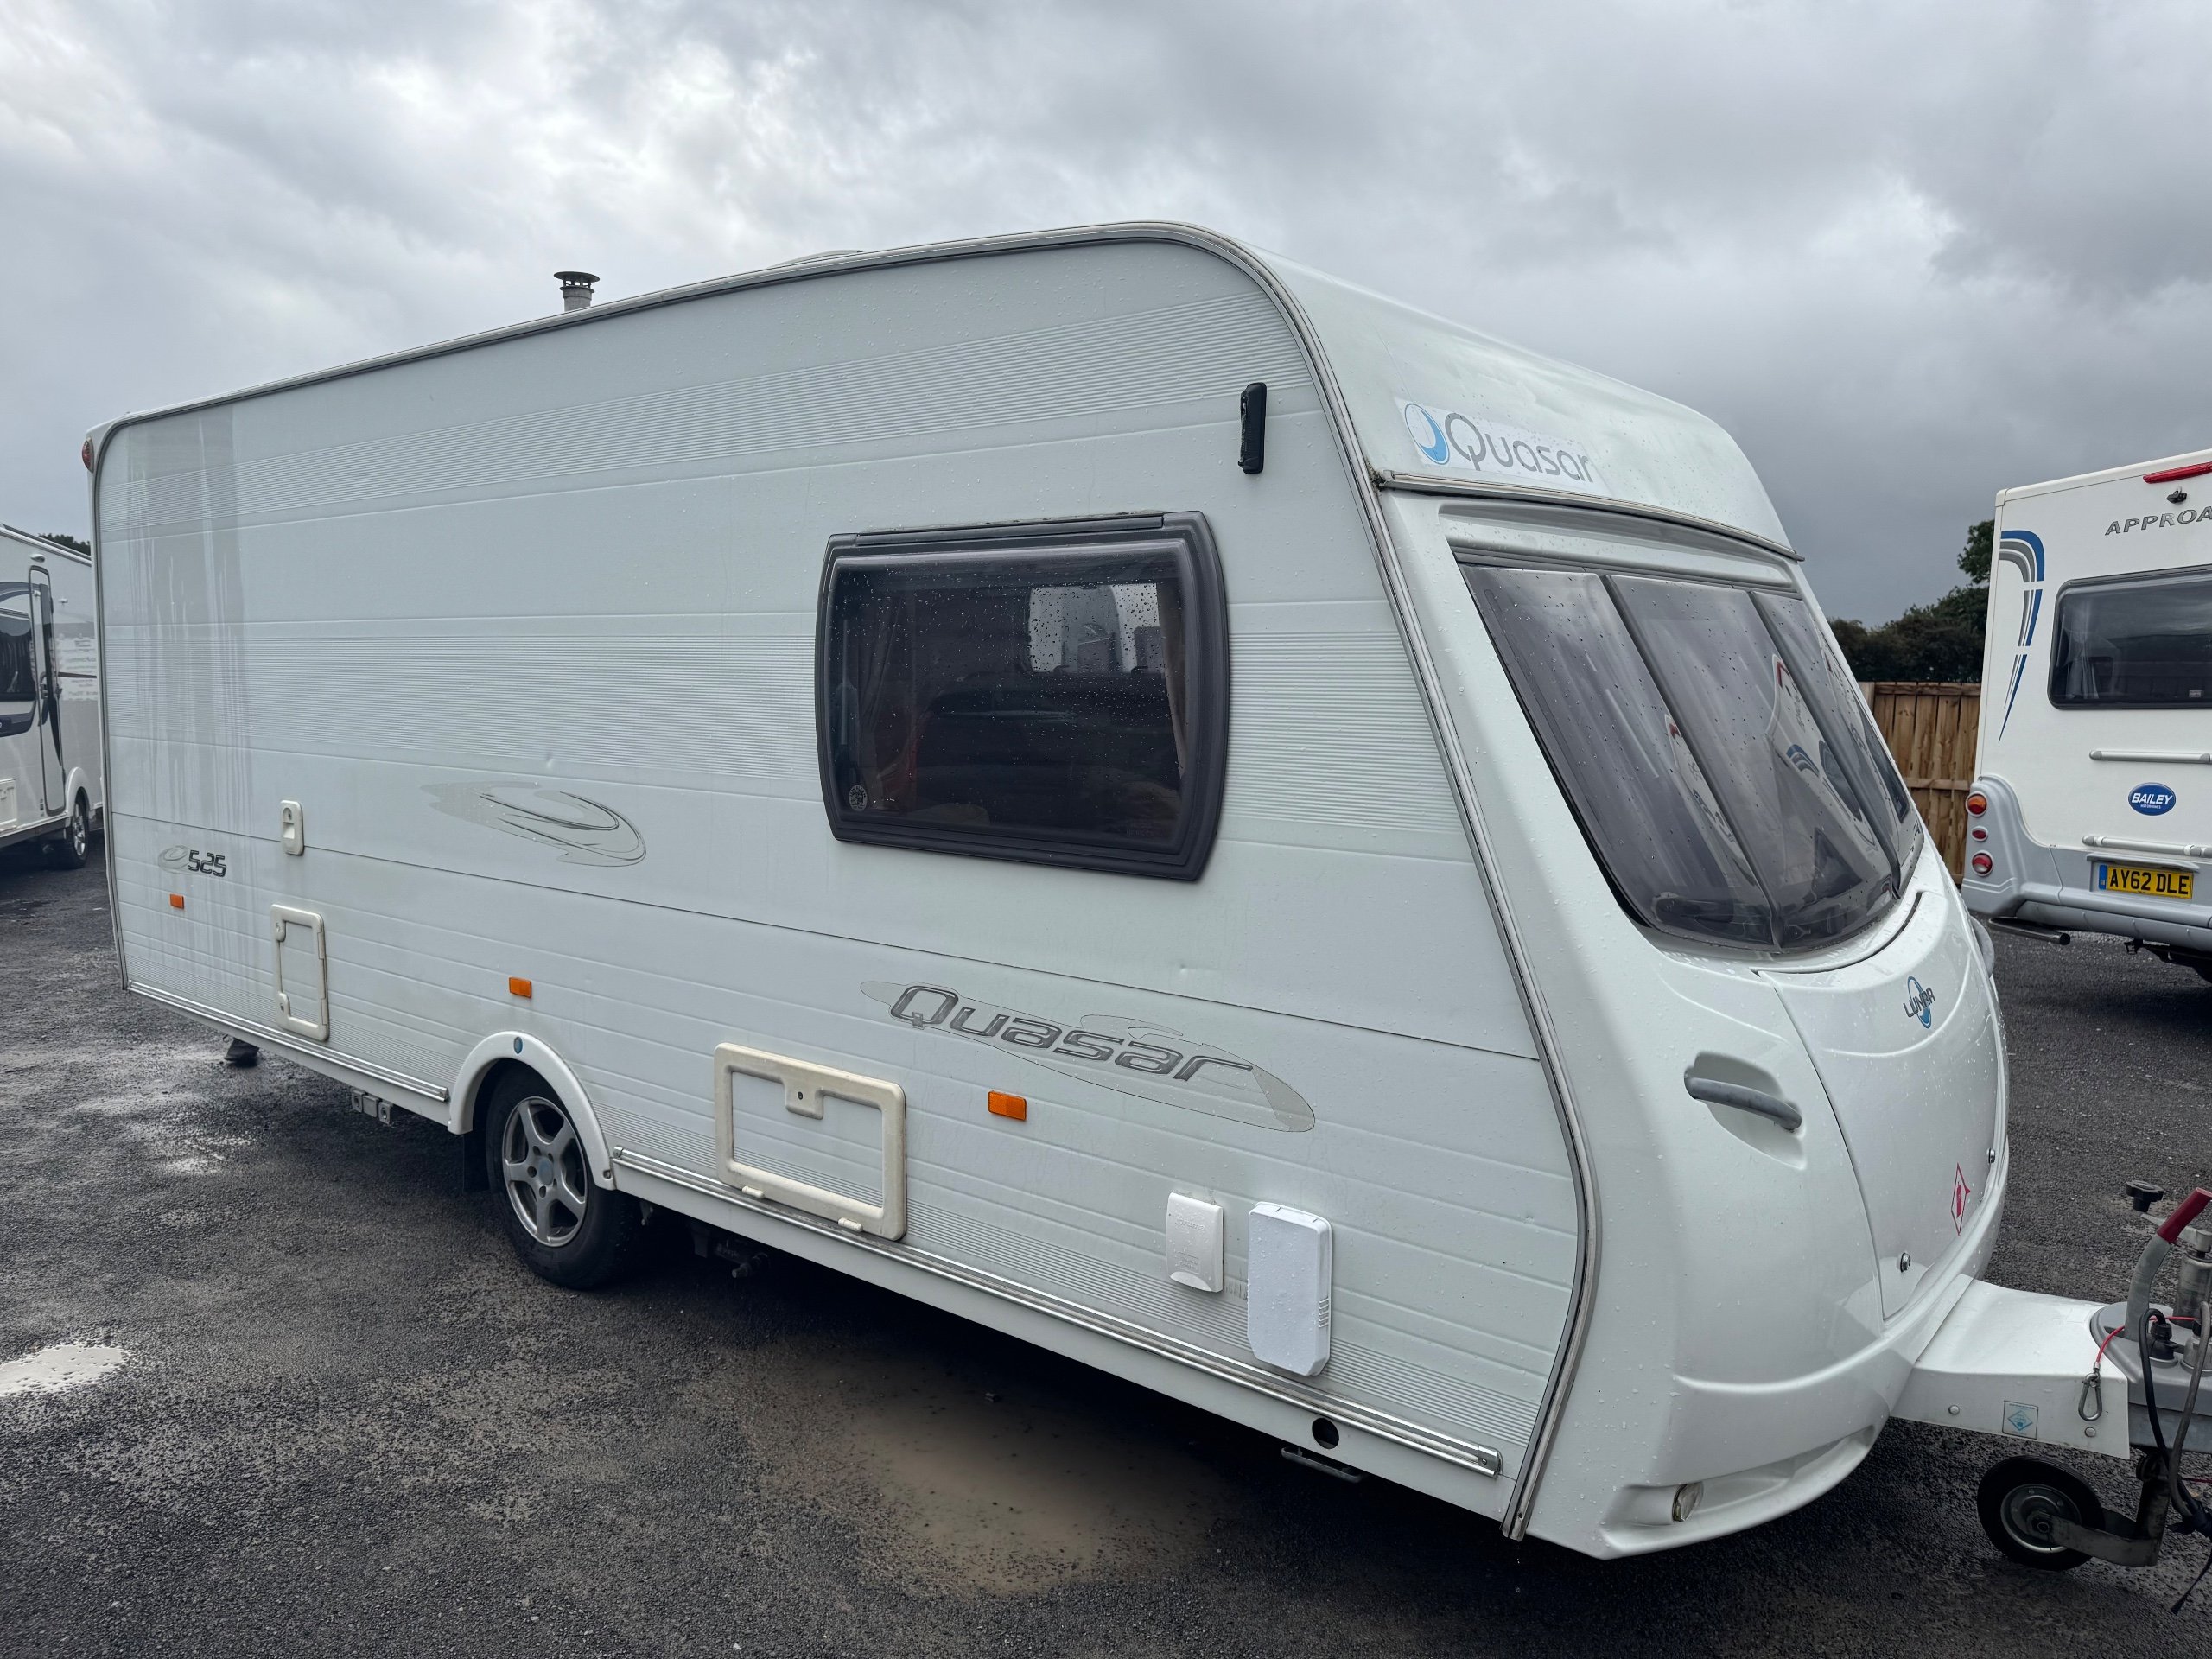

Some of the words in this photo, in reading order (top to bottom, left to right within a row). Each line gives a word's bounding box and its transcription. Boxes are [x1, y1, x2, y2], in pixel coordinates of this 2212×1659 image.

[1444, 412, 1593, 483] Quasar
[2104, 505, 2212, 536] APPROA
[2131, 792, 2173, 805] BAILEY
[187, 849, 227, 878] 525
[2109, 868, 2152, 891] AY62
[2156, 873, 2190, 895] DLE
[1903, 987, 1936, 1018] LUNAR
[890, 984, 1254, 1082] Quasar
